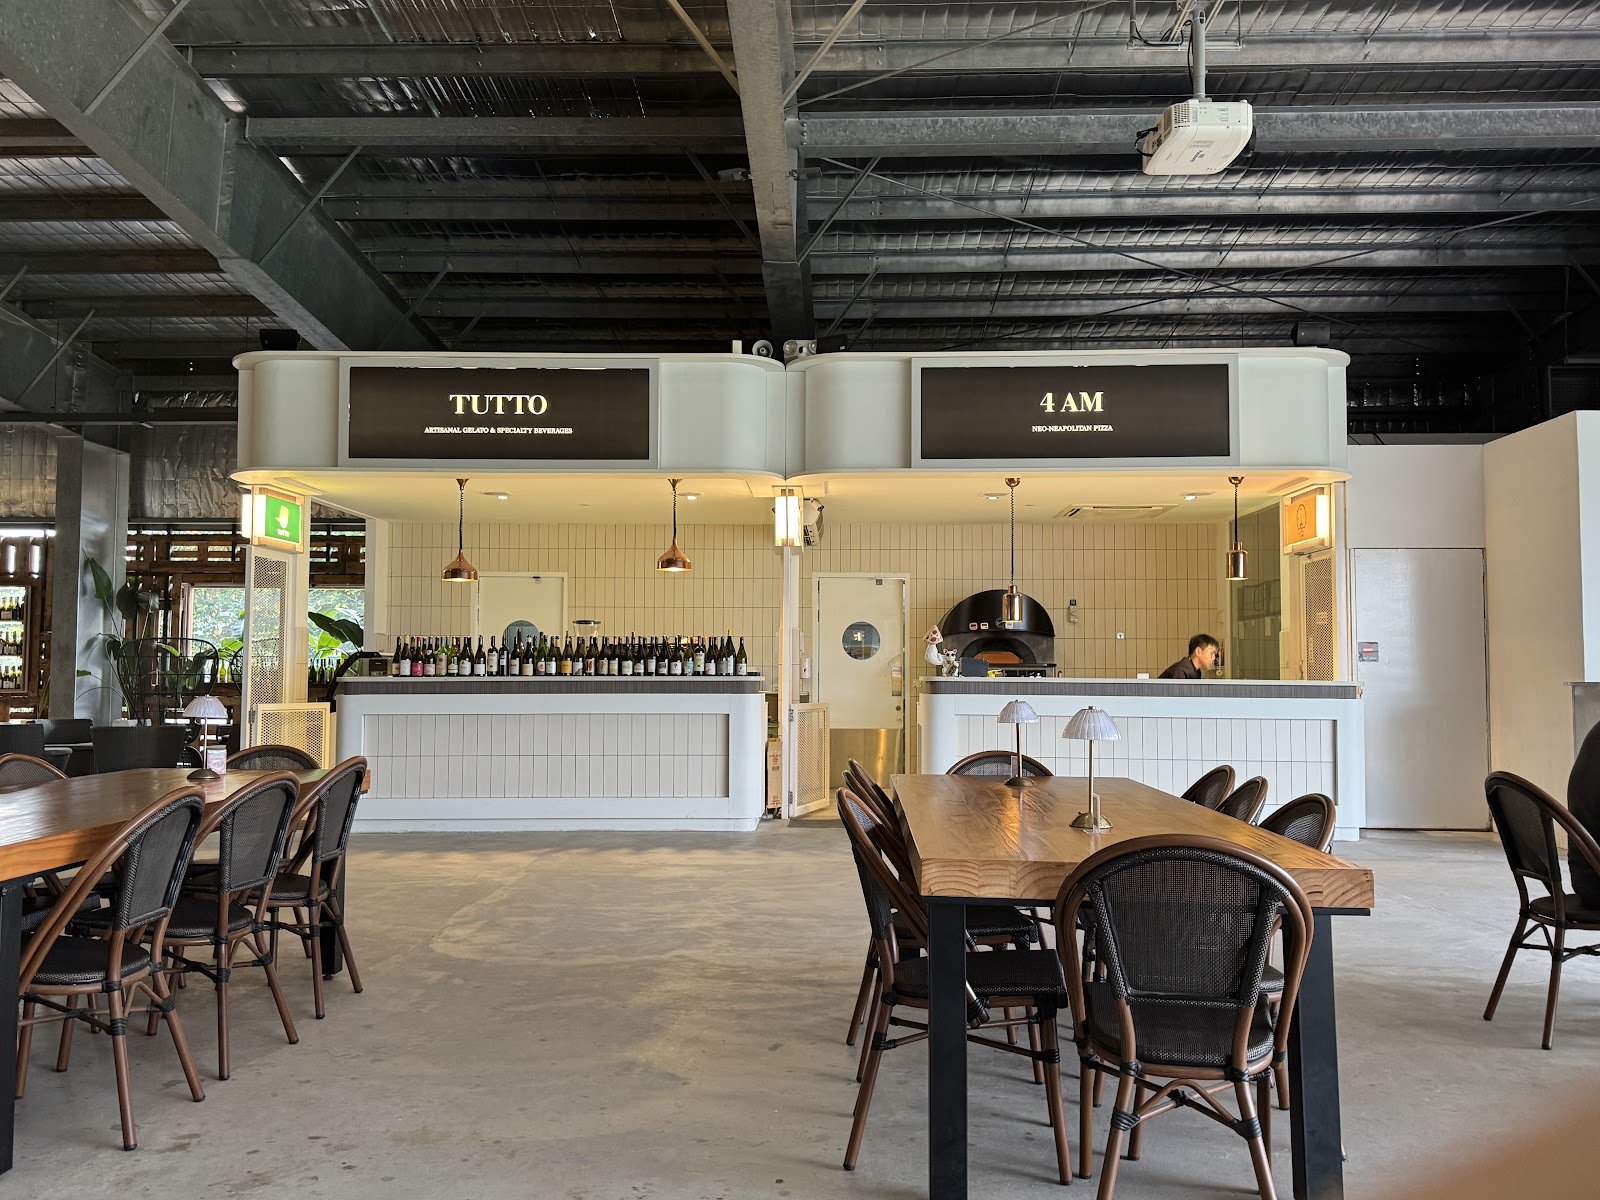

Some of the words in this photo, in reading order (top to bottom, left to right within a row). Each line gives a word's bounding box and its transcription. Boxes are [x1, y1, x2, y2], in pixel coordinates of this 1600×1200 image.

[449, 394, 548, 415] TUTTO
[1039, 392, 1056, 413] 4
[1060, 391, 1104, 412] AM
[1093, 424, 1114, 432] PIZZA
